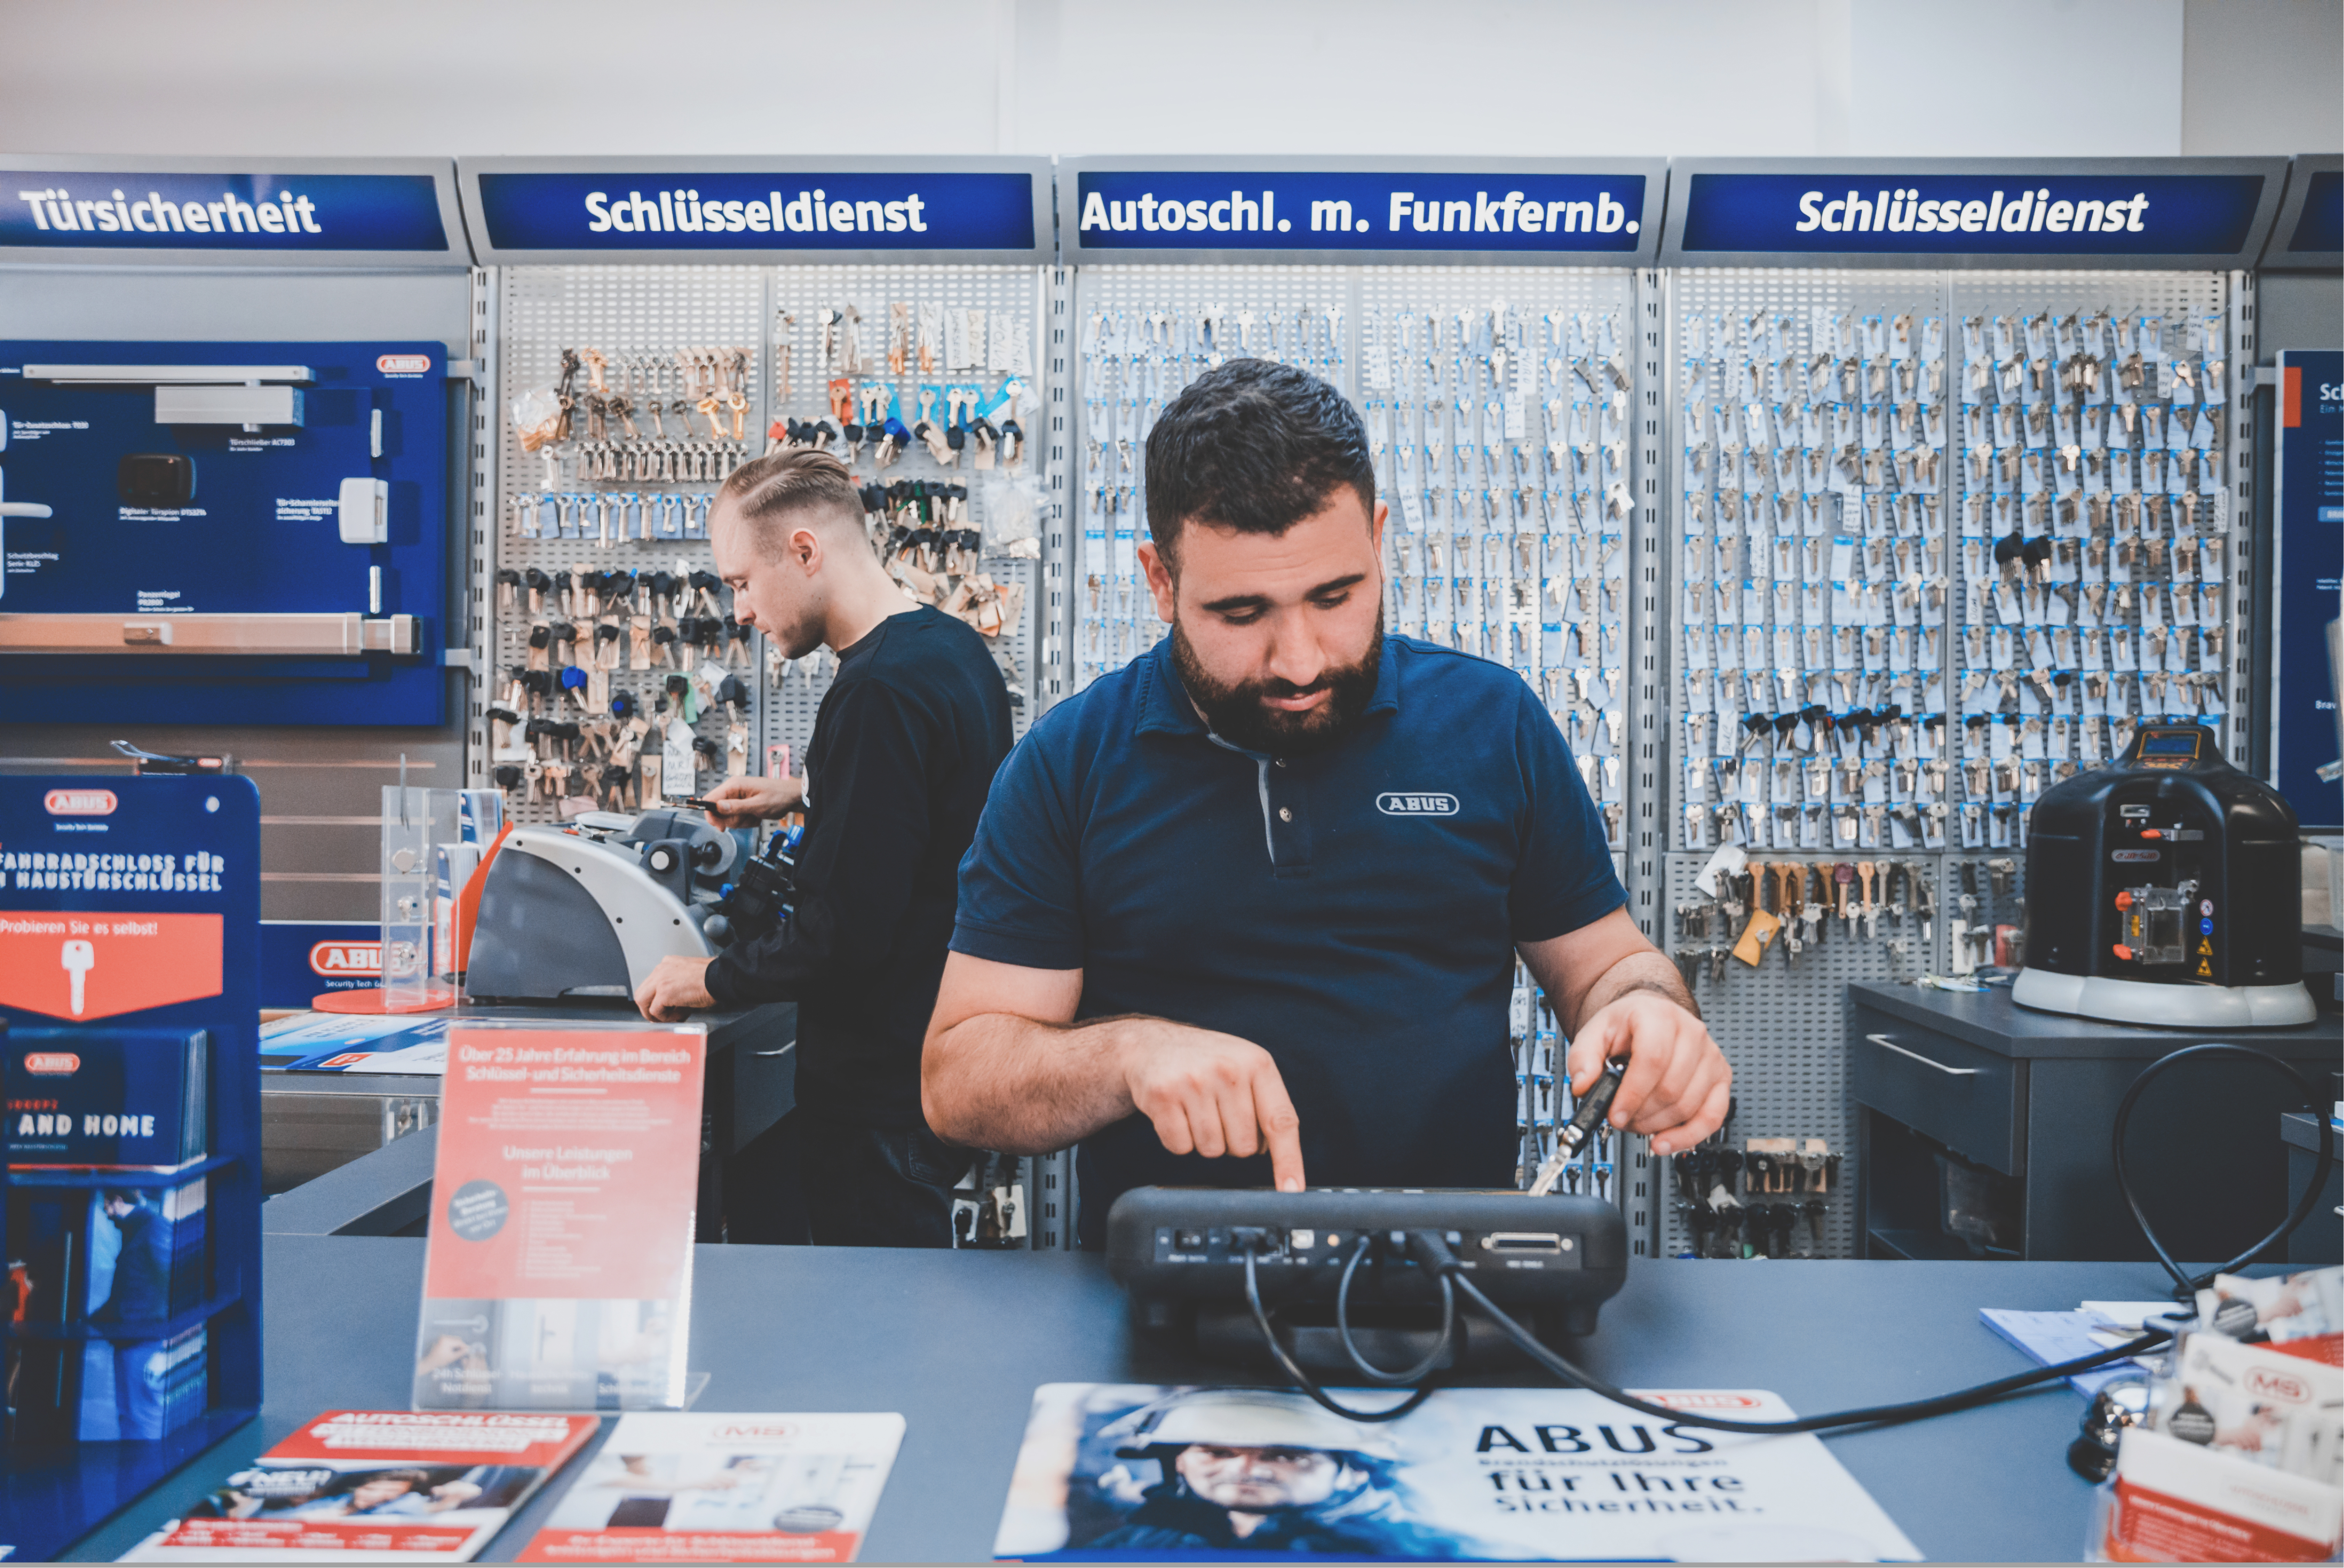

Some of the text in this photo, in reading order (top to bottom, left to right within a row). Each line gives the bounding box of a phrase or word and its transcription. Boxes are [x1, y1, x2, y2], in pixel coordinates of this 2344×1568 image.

[18, 188, 322, 233] Türsicherheit
[585, 189, 927, 232] Schlüsseldienst
[1080, 190, 1640, 234] Autoschl. m. Funkfernb.
[1796, 188, 2149, 232] Schlüsseldienst
[386, 360, 423, 369] ABUS
[56, 796, 108, 809] ABUS
[1389, 797, 1449, 811] ABUS
[185, 851, 224, 873] FÜR
[16, 867, 222, 891] HAUSTÜRSCHLÜSSEL
[0, 919, 158, 934] Probieren Sie es selbst!
[325, 979, 355, 989] Security
[34, 1057, 74, 1067] ABUS
[460, 1045, 691, 1066] Über 25 Jahre Erfahrung im Bereich
[533, 1066, 559, 1082] und
[561, 1066, 681, 1083] Sicherheitsdienste
[18, 1113, 155, 1137] AND HOME
[503, 1145, 633, 1164] Unsere Leistungen
[521, 1162, 610, 1179] im Überblick
[330, 1413, 568, 1427] AUTOSCHLÜSSEL
[1475, 1424, 1715, 1454] ABUS
[1487, 1470, 1745, 1492] für Ihre
[1495, 1496, 1764, 1513] Sicherheit.
